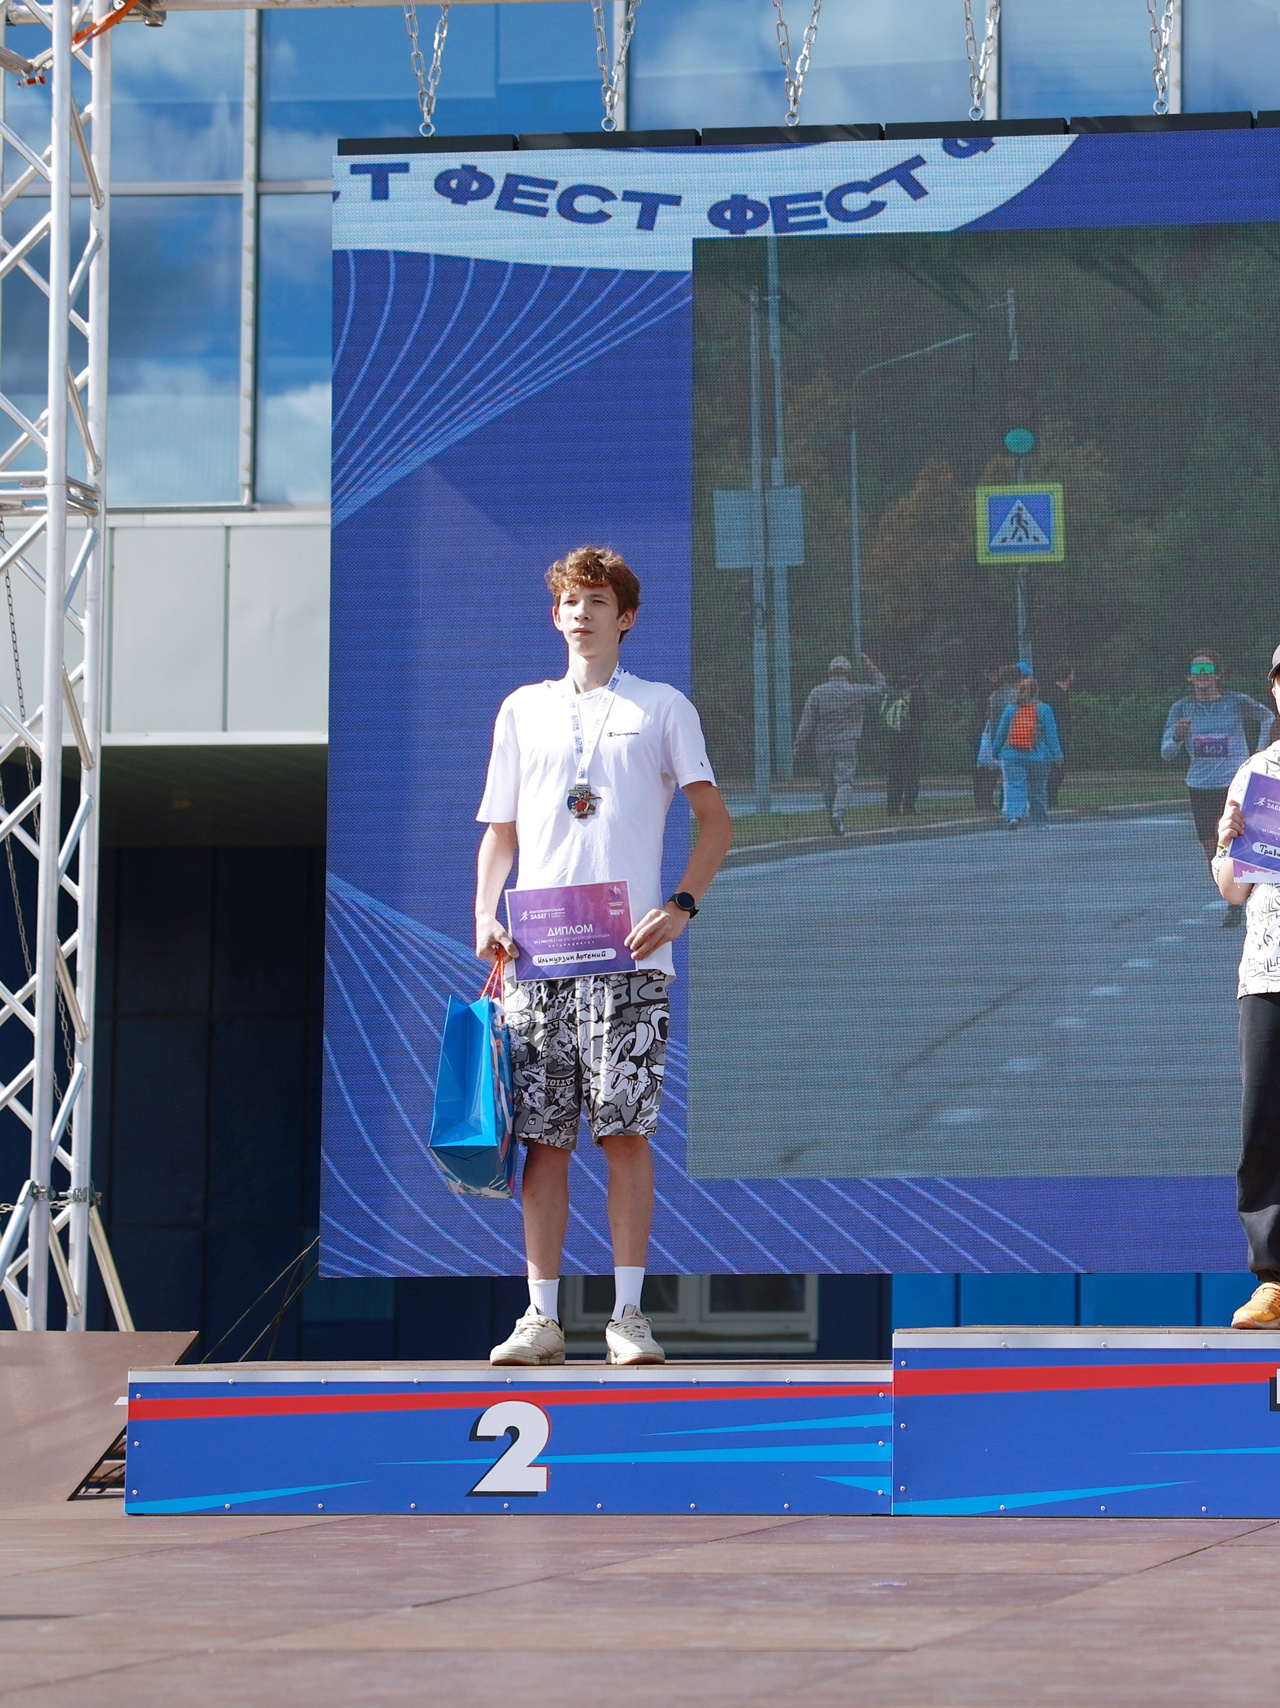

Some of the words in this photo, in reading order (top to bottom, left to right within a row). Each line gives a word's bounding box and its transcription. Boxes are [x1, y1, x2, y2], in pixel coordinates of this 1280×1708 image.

[434, 163, 682, 232] ФЕСТ
[707, 154, 929, 235] ФЕСТ
[547, 924, 593, 937] ДИПЛОМ
[469, 1400, 552, 1496] 2
